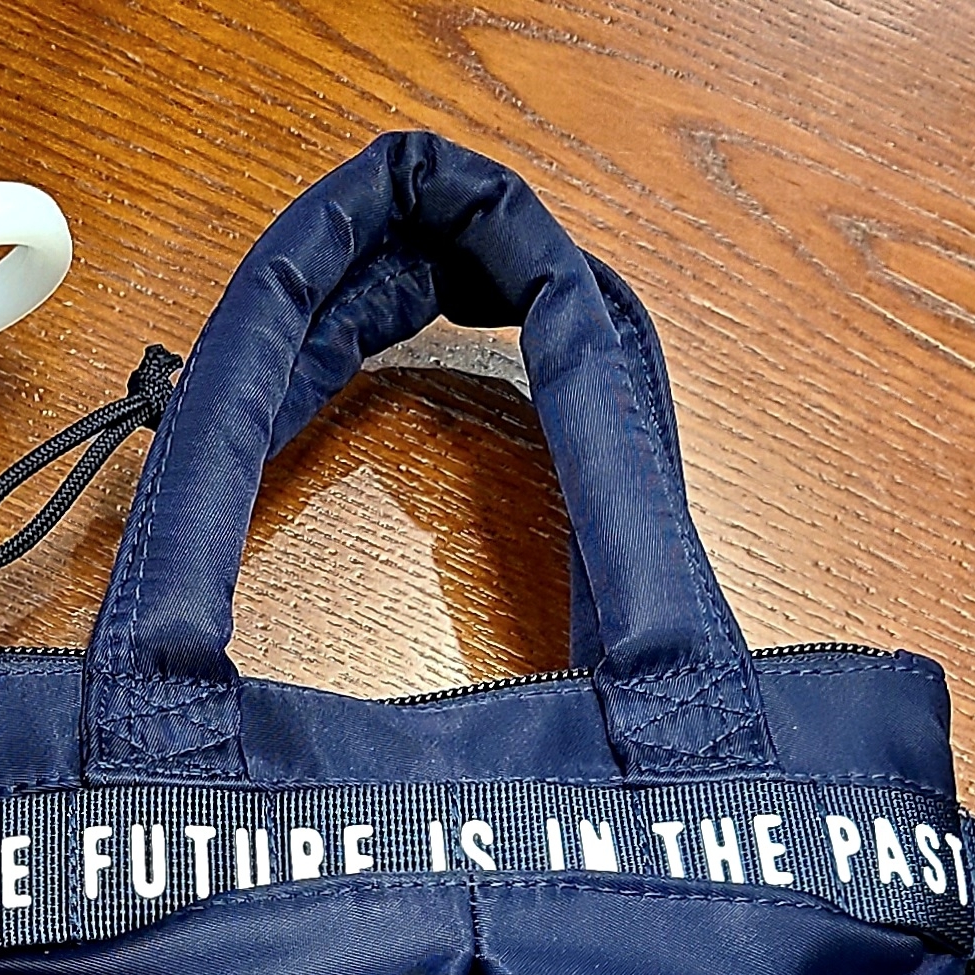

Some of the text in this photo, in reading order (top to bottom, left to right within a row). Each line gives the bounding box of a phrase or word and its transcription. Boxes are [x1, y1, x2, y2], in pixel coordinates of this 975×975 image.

[83, 824, 375, 901] FUTURE
[430, 820, 495, 872] IS
[545, 818, 620, 873] IN
[651, 814, 794, 886] THE
[825, 815, 968, 906] PAST
